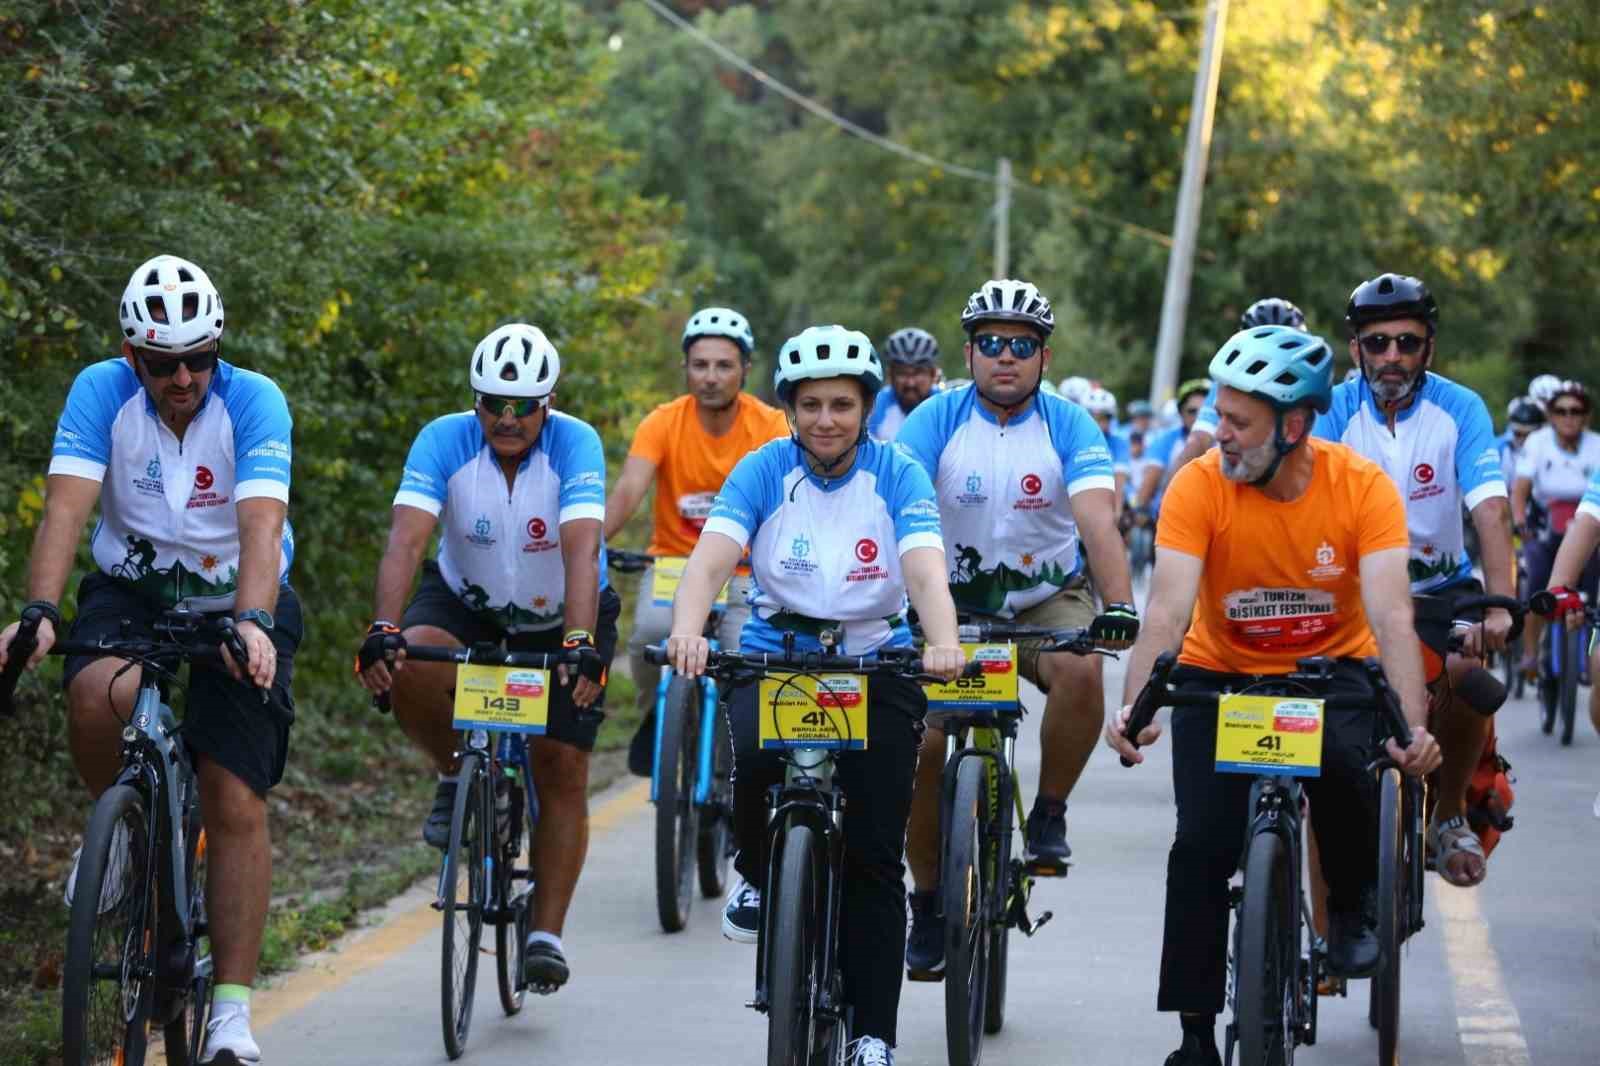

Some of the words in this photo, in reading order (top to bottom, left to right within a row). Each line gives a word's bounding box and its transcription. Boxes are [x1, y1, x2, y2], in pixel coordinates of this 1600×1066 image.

[1262, 591, 1306, 602] TURİZM
[1229, 604, 1277, 618] BİSİKLET
[483, 696, 520, 711] 143
[801, 711, 826, 726] 41
[1256, 735, 1281, 750] 41
